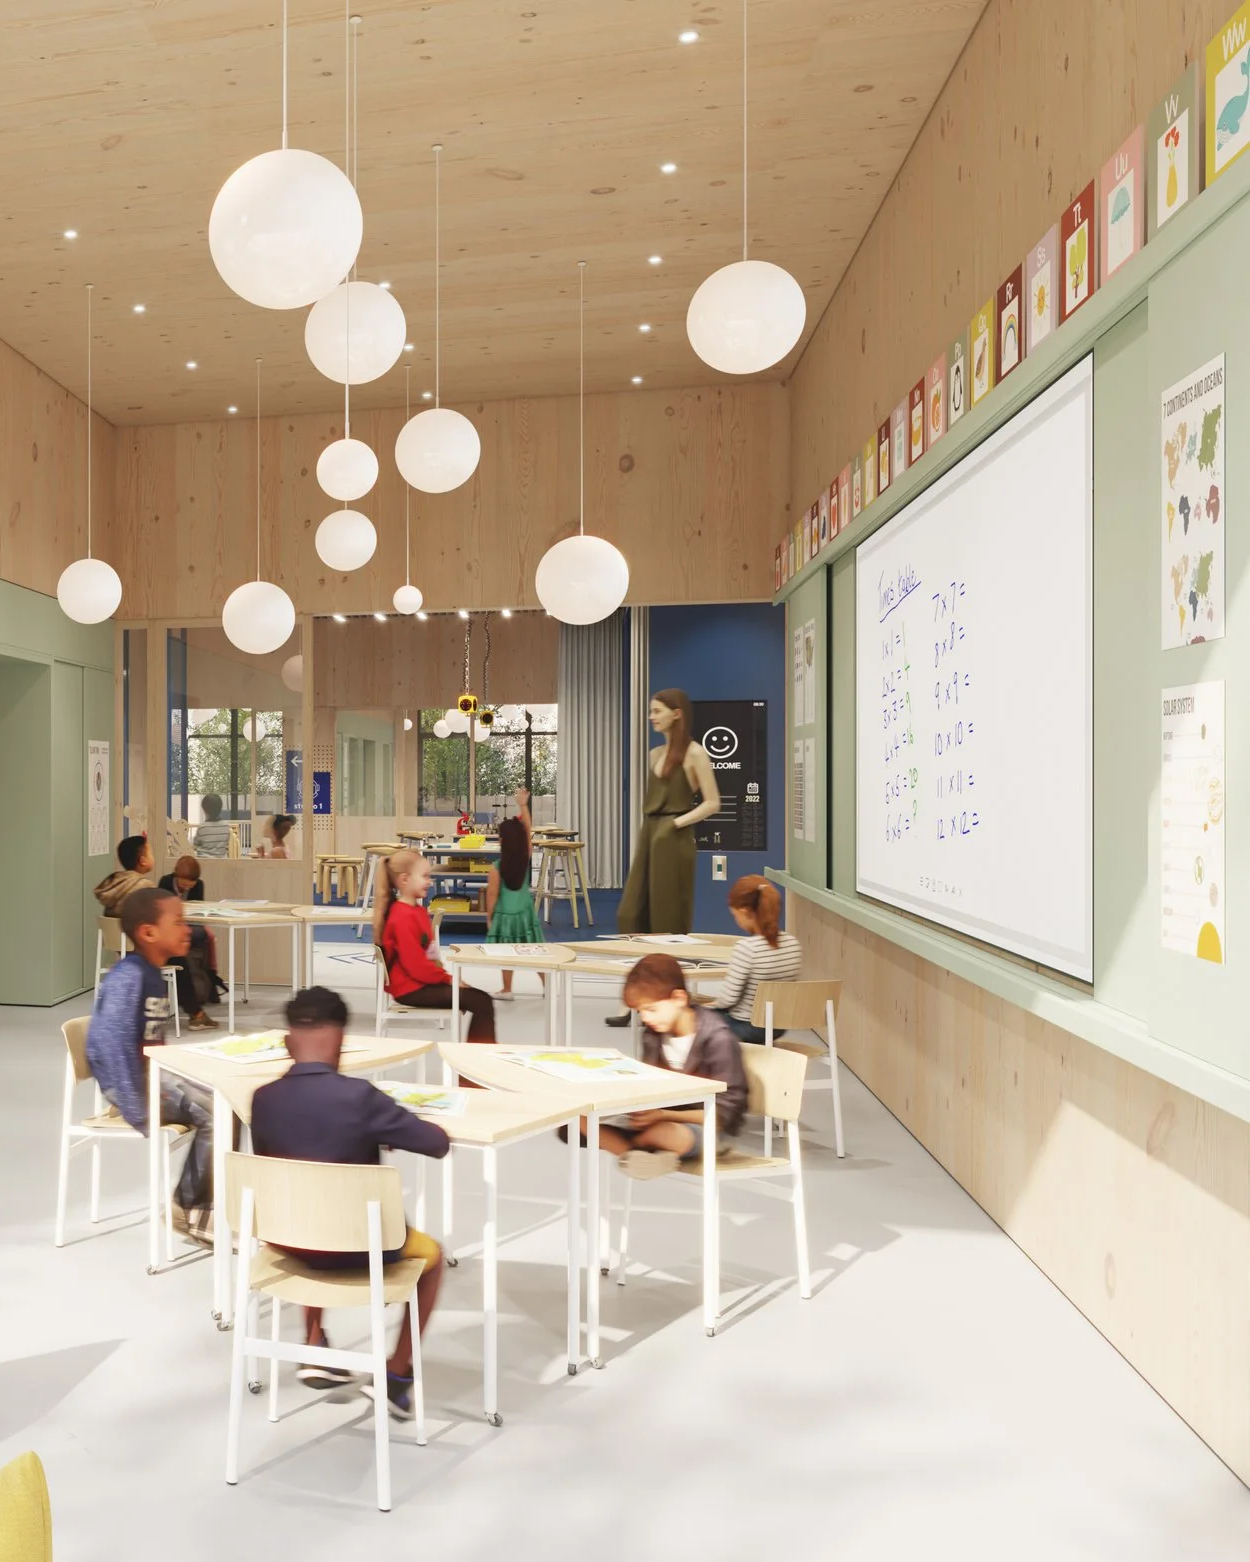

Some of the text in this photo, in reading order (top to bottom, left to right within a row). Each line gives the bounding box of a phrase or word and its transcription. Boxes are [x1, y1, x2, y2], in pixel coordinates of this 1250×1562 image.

[1115, 154, 1128, 180] Uu
[1073, 202, 1082, 227] Tt
[1163, 367, 1223, 419] 7 CONTINENTS AND OCEANS
[1163, 696, 1195, 716] SOLAR SYSTEM
[710, 762, 741, 770] ELCOME
[745, 795, 760, 803] 2022
